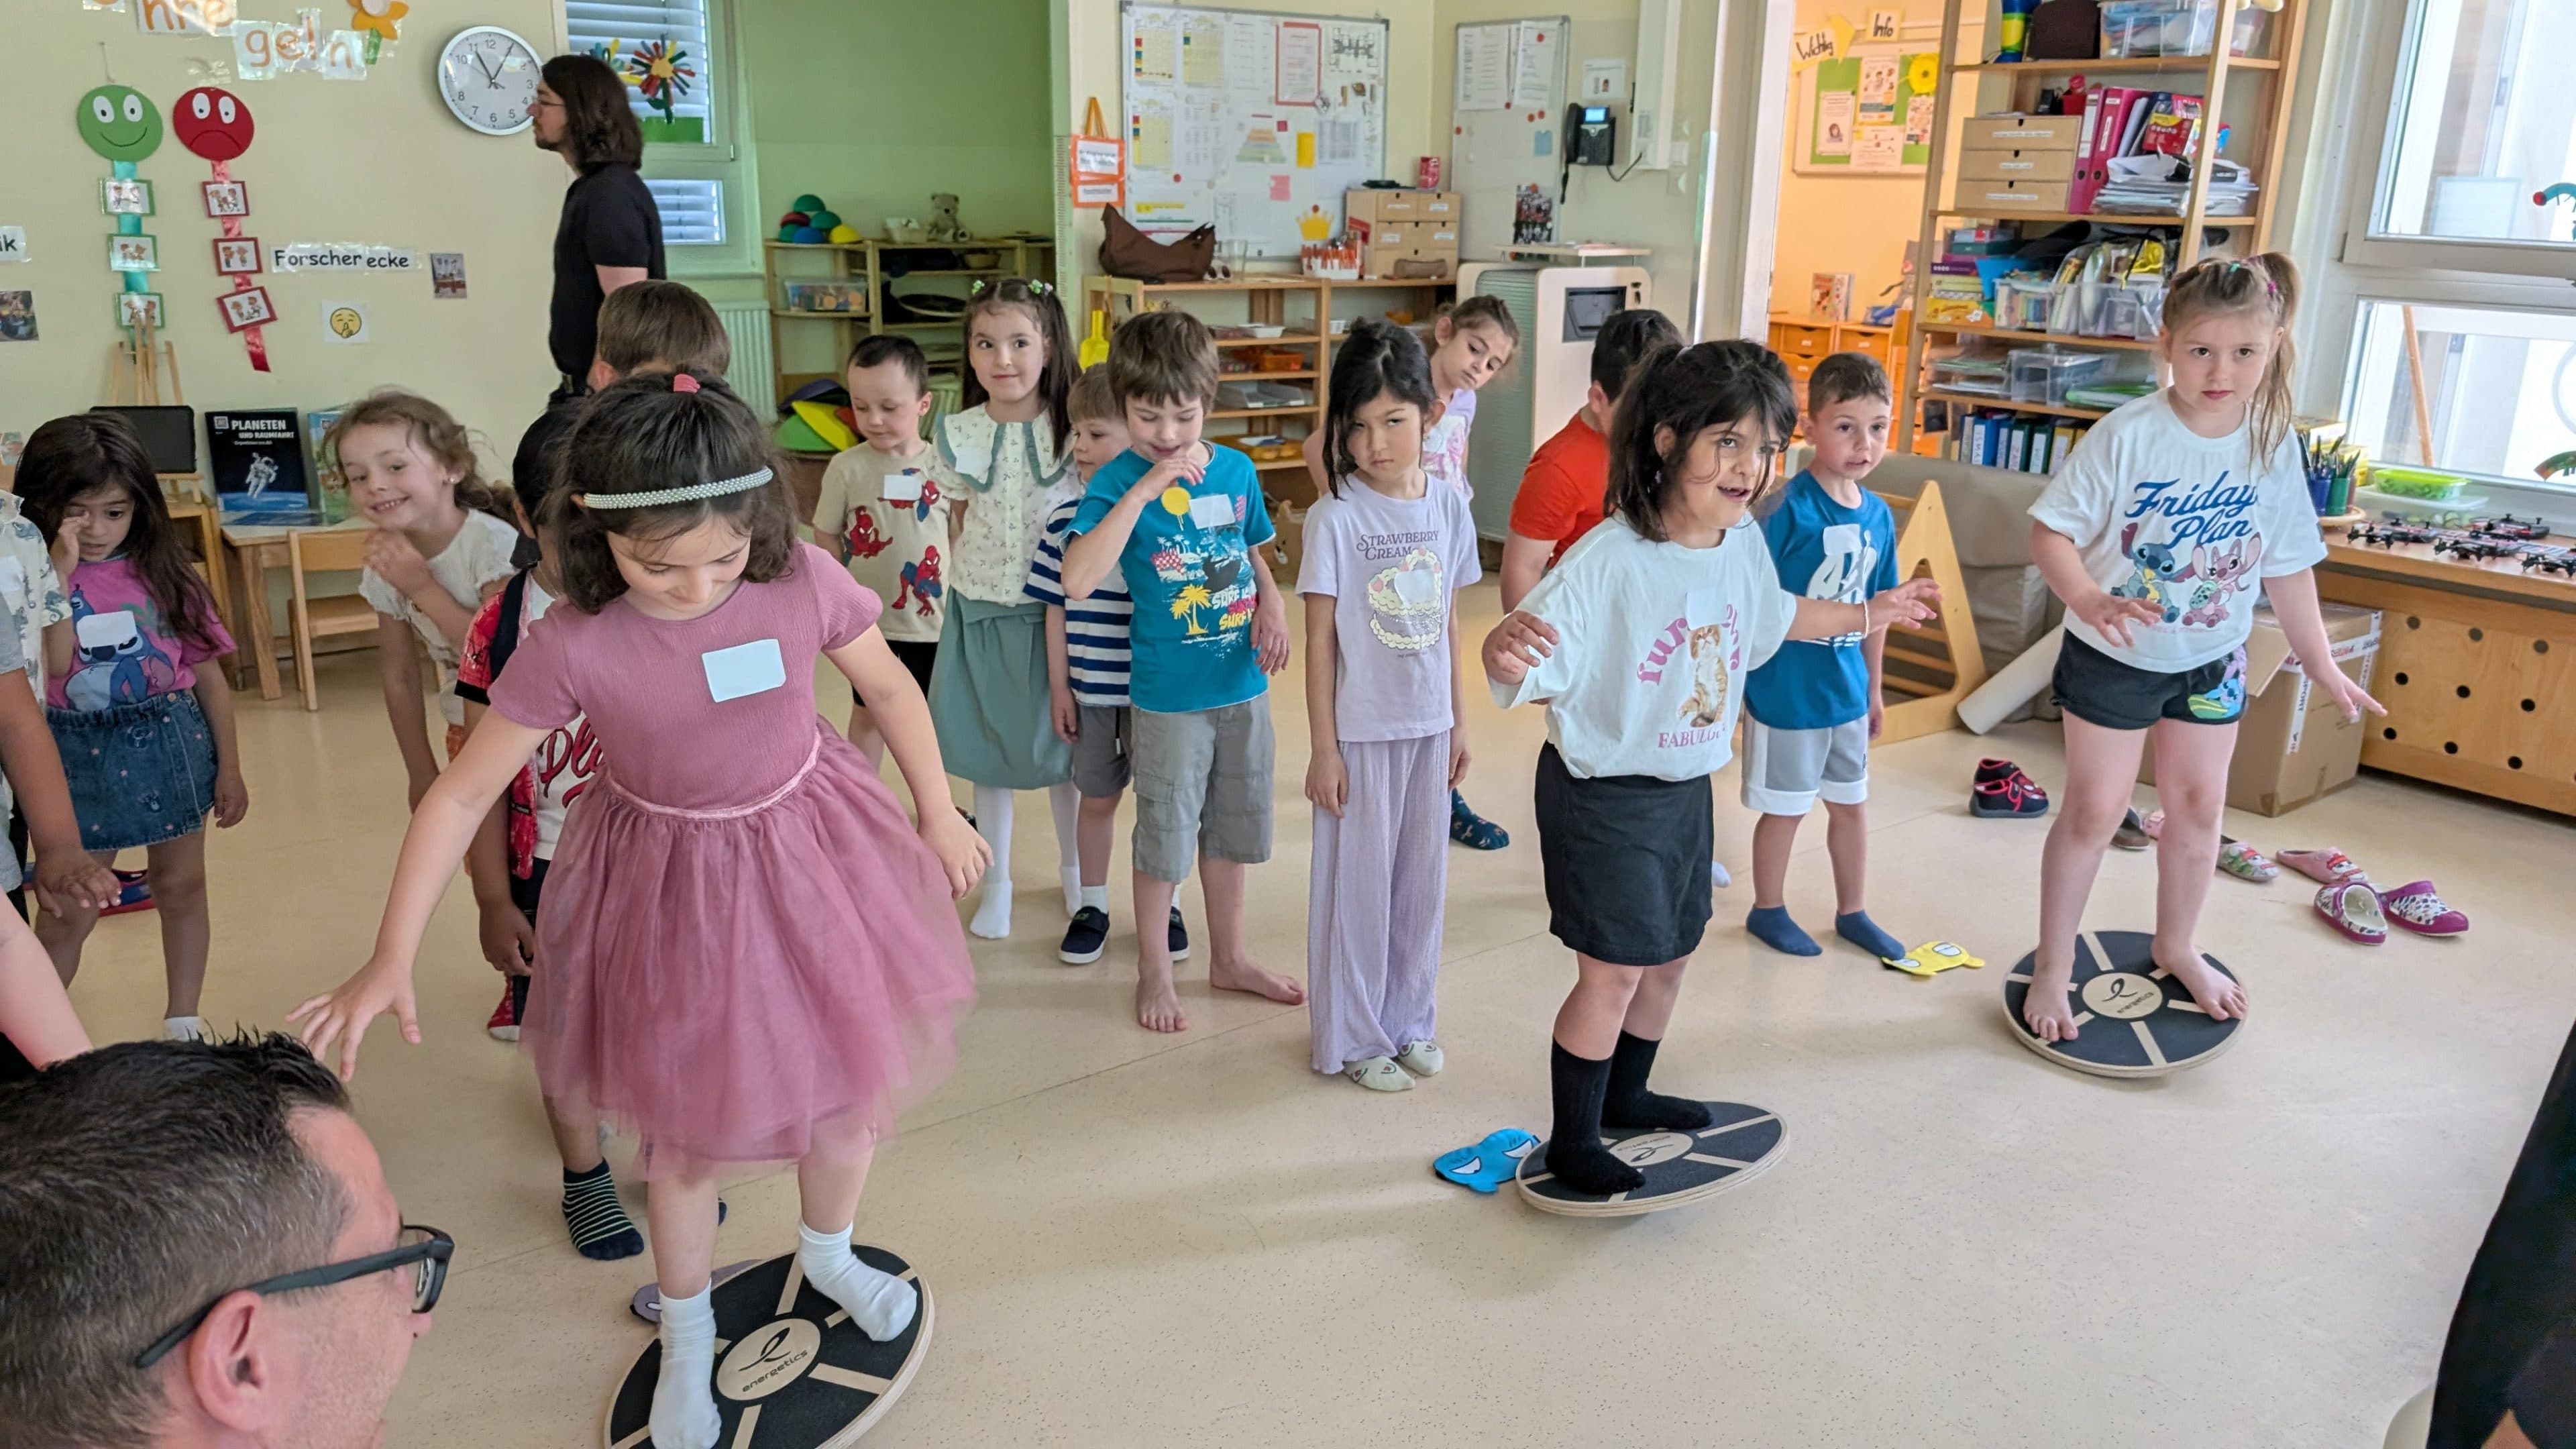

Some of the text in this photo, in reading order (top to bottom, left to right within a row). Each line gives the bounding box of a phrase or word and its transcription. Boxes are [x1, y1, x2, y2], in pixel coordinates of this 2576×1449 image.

[485, 39, 496, 50] 12
[455, 54, 468, 65] 10
[527, 79, 534, 89] 3
[458, 91, 466, 101] 8
[472, 105, 479, 115] 7
[508, 109, 516, 119] 5
[490, 113, 498, 123] 6
[231, 419, 286, 431] PLANETEN
[2125, 470, 2258, 519] Friday
[2165, 508, 2253, 550] Plan
[1356, 531, 1439, 552] STRAWBERRY
[1364, 546, 1412, 561] CREAM
[742, 1349, 808, 1392] energetics
